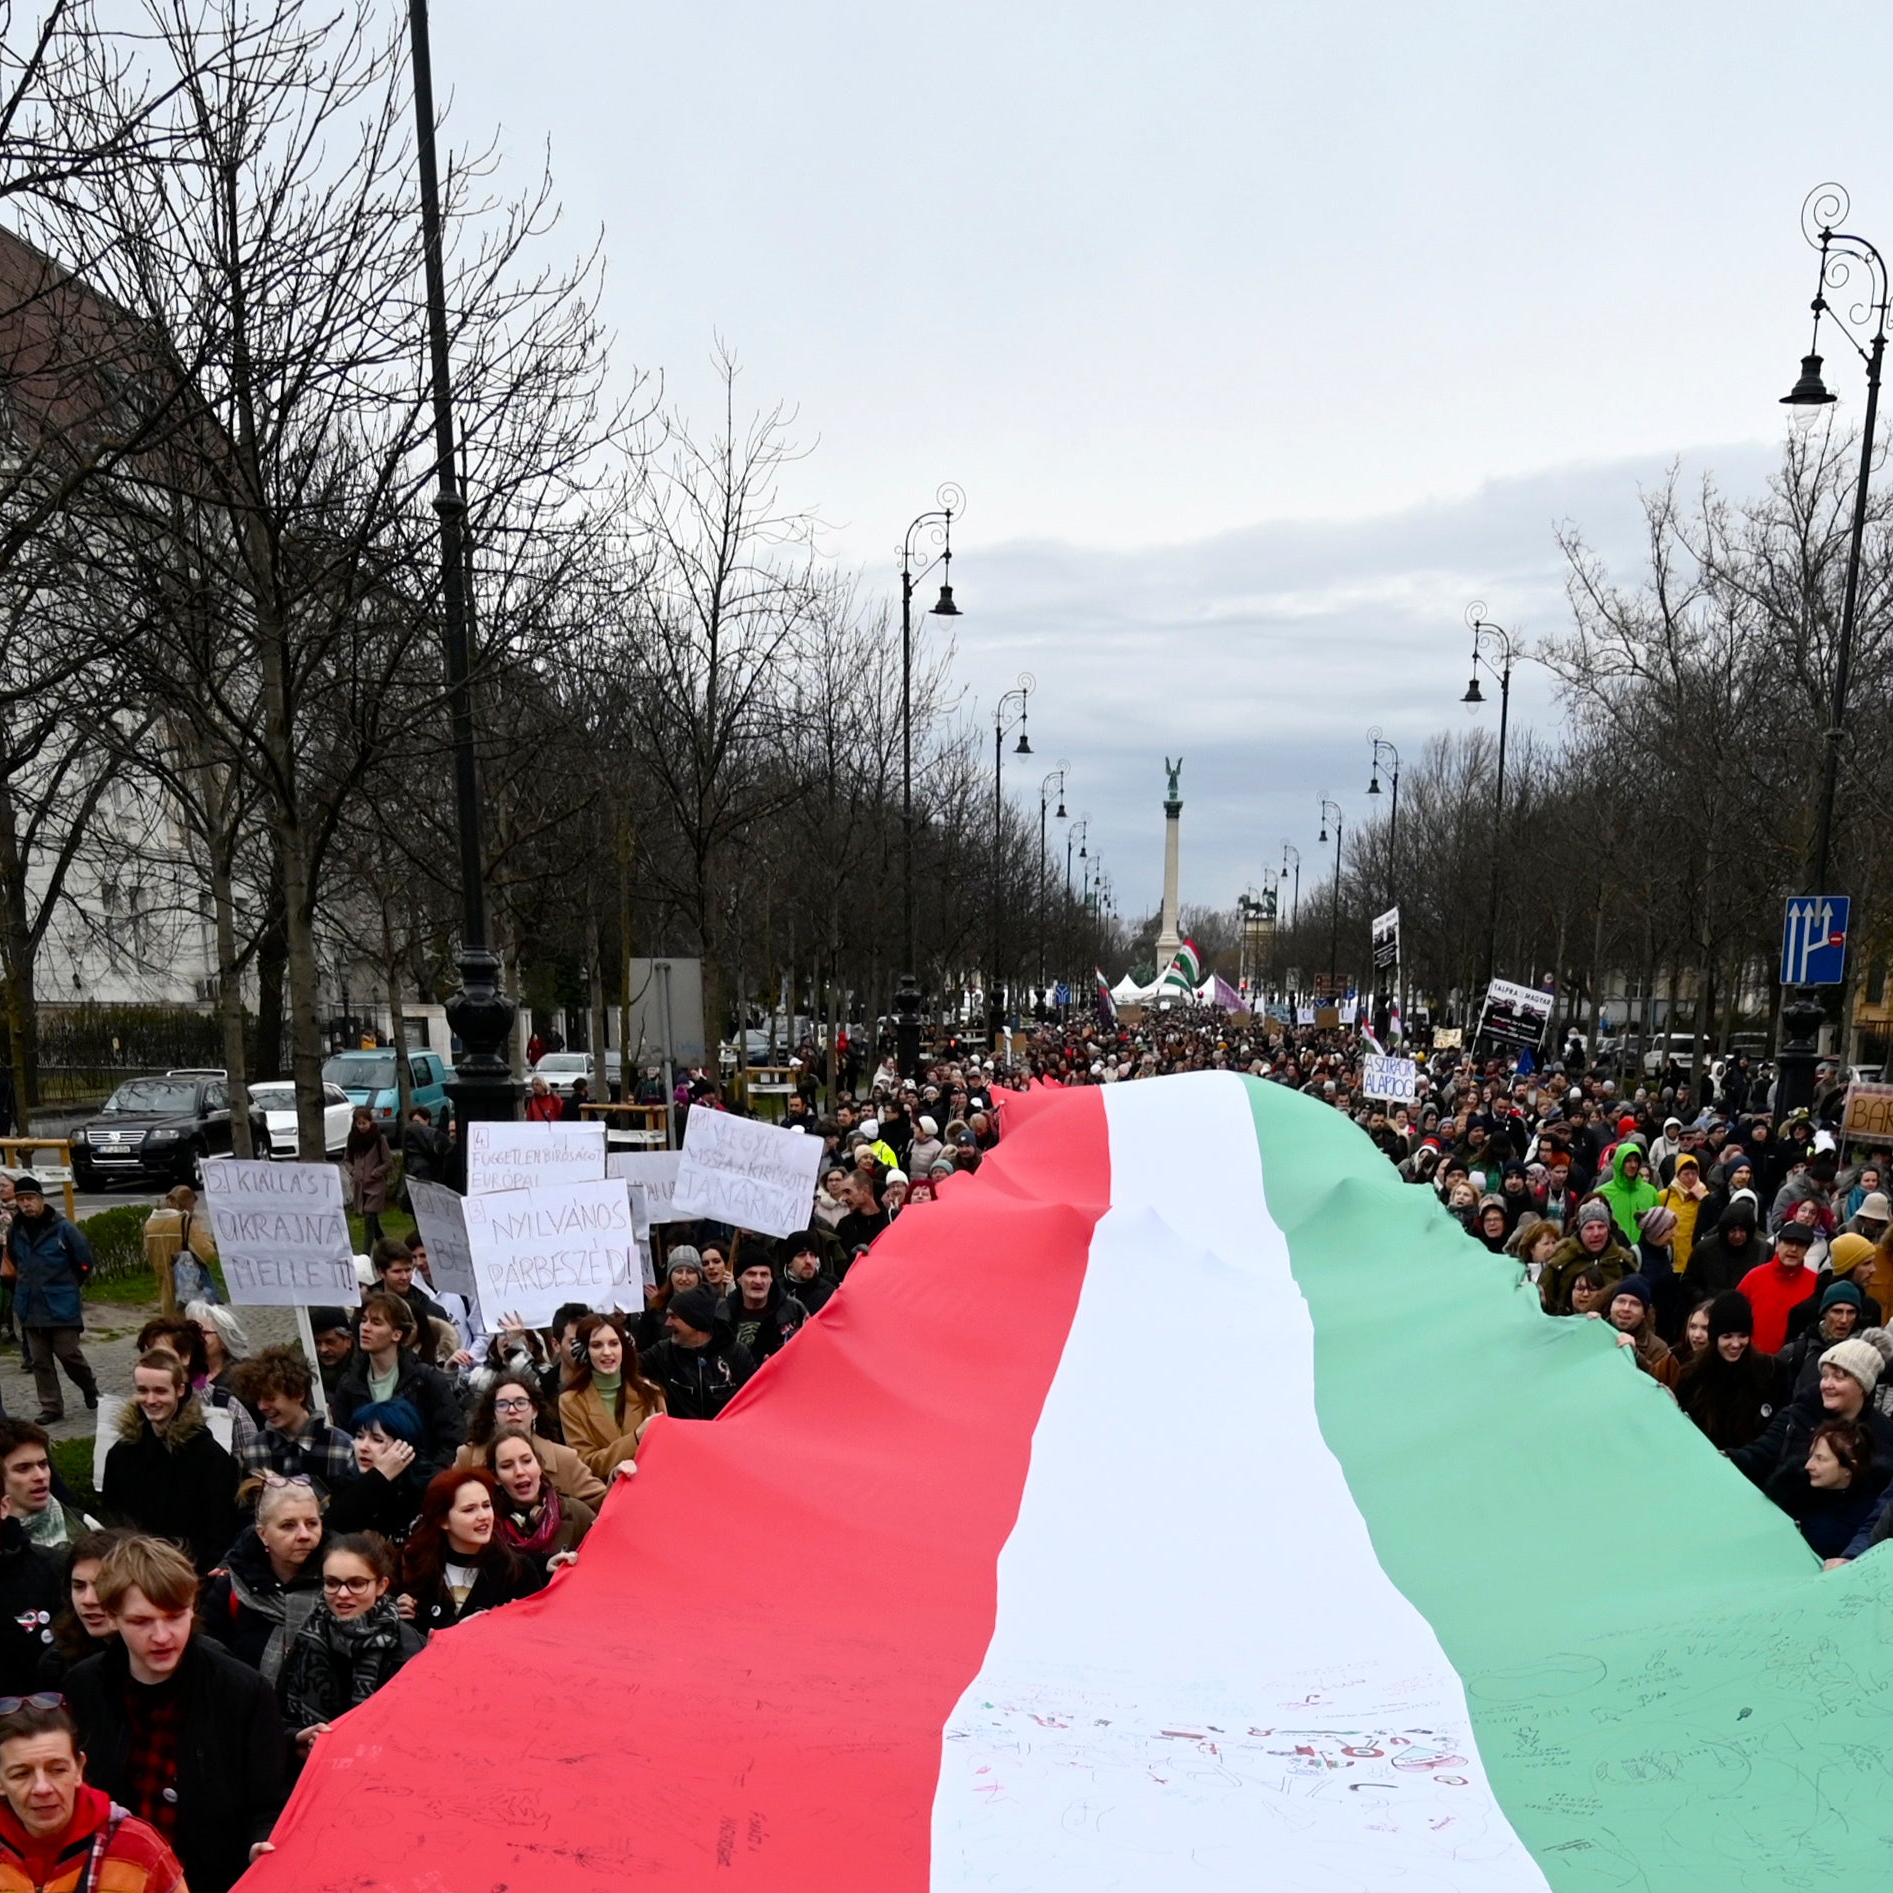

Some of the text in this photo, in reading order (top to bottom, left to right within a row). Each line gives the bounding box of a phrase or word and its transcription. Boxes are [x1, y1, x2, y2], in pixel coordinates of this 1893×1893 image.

[1365, 1073, 1414, 1098] ALAPJOG
[491, 1197, 627, 1244] NYILVÁNOS
[488, 1237, 633, 1297] PÁRBESZÉD!
